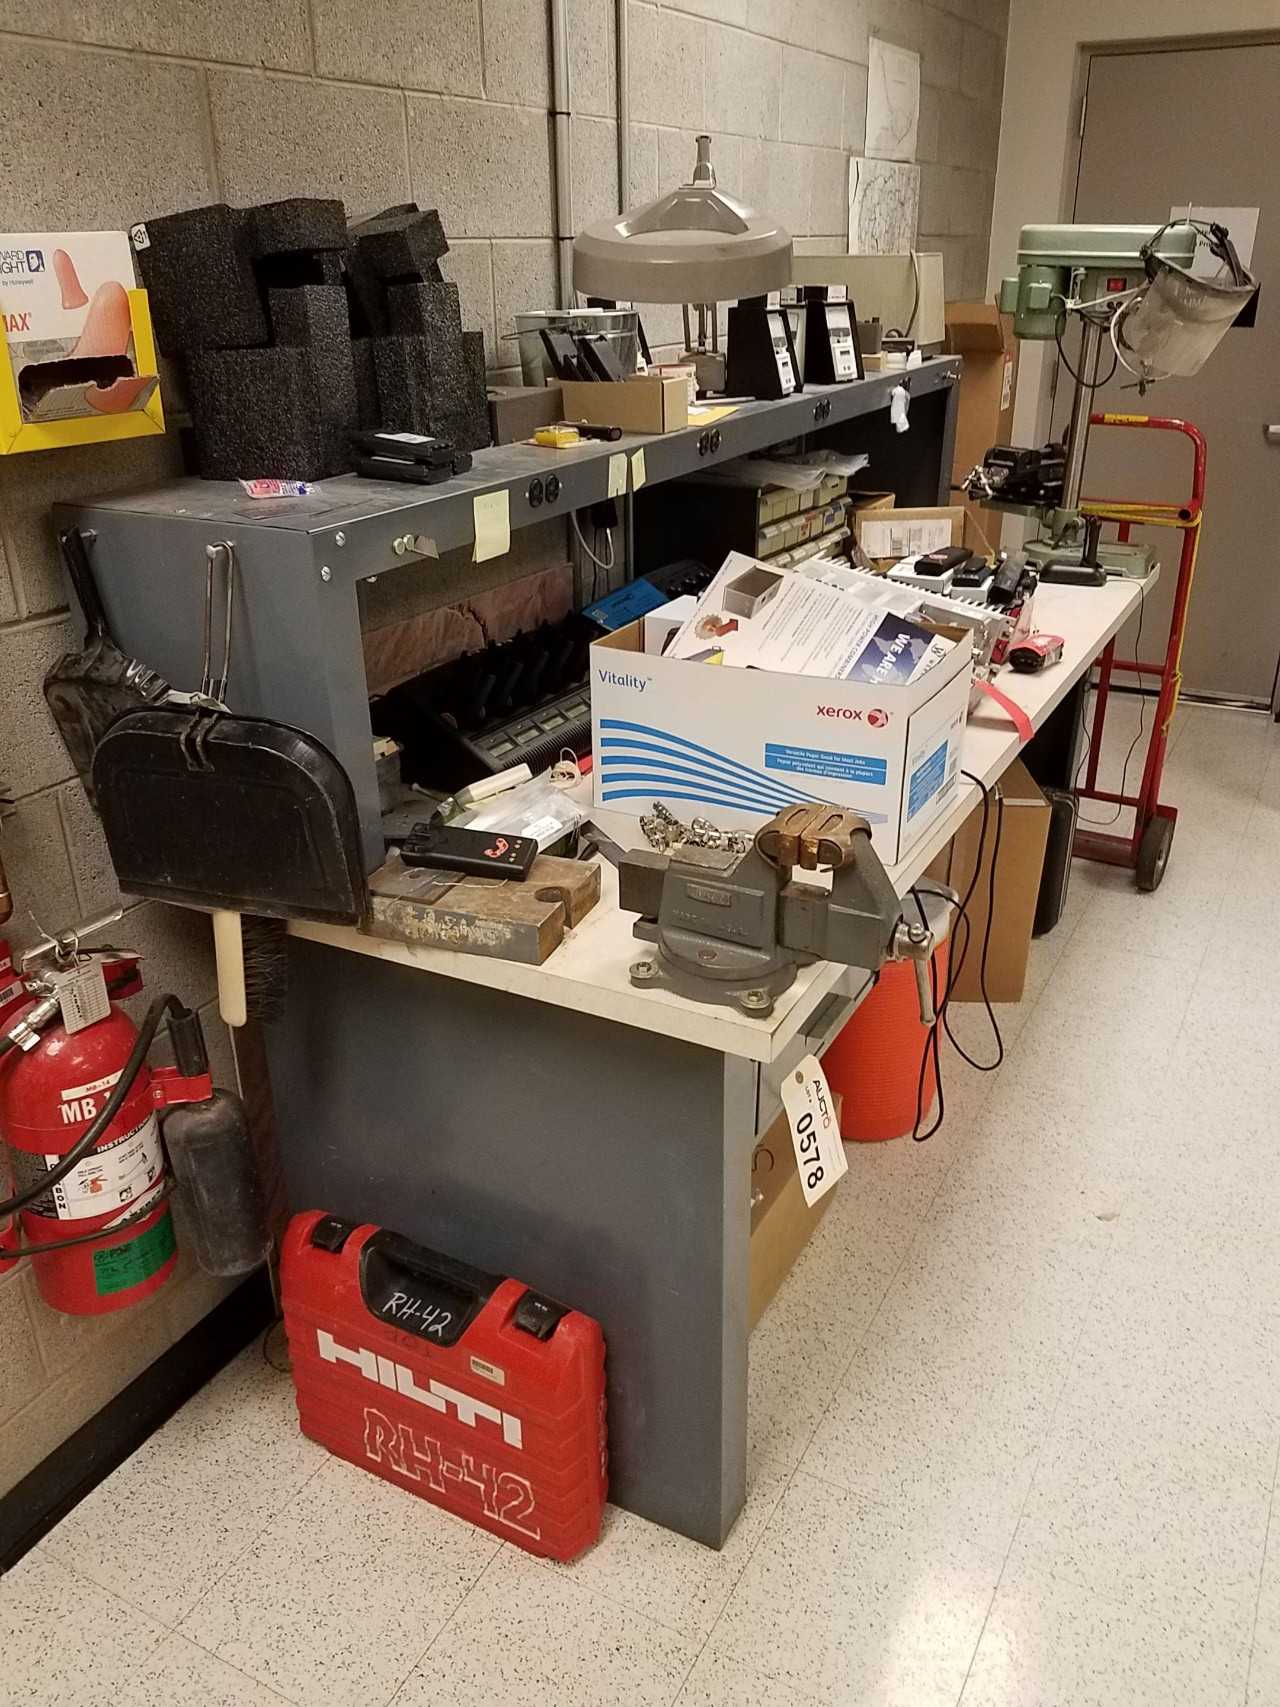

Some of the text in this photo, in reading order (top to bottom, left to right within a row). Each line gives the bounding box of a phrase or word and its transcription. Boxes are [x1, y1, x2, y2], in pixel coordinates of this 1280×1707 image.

[0, 260, 25, 274] GHT
[876, 633, 911, 678] WE ARE
[598, 669, 647, 692] Vitality
[816, 705, 863, 721] xerox
[60, 1097, 97, 1124] MB
[796, 1112, 825, 1189] 0578
[381, 1291, 452, 1337] RH-42
[316, 1328, 523, 1450] HILTI
[363, 1407, 542, 1541] RH-42
